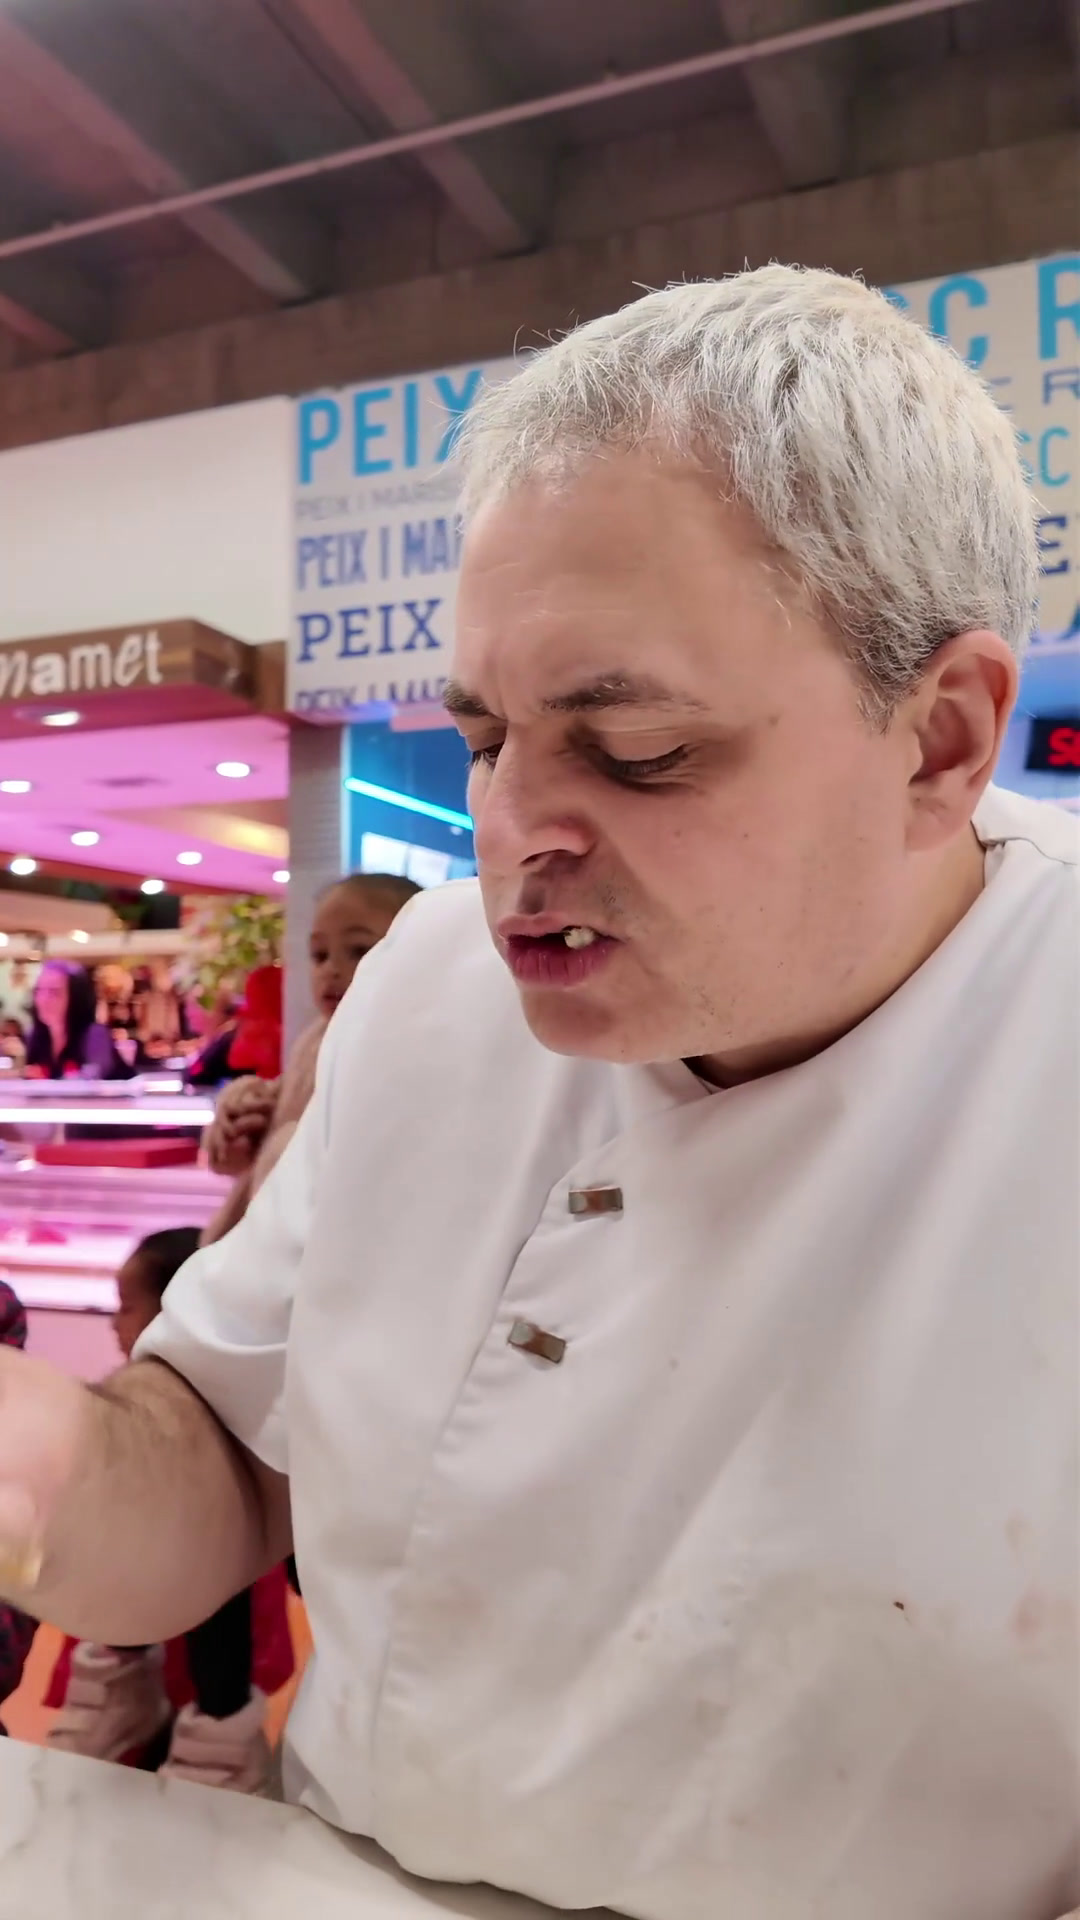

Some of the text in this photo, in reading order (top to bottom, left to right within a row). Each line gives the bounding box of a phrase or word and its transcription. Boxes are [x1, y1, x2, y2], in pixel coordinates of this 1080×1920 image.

[299, 369, 483, 485] PEIX
[296, 529, 367, 590] PEIX
[379, 525, 390, 581] I
[297, 599, 442, 664] PEIX
